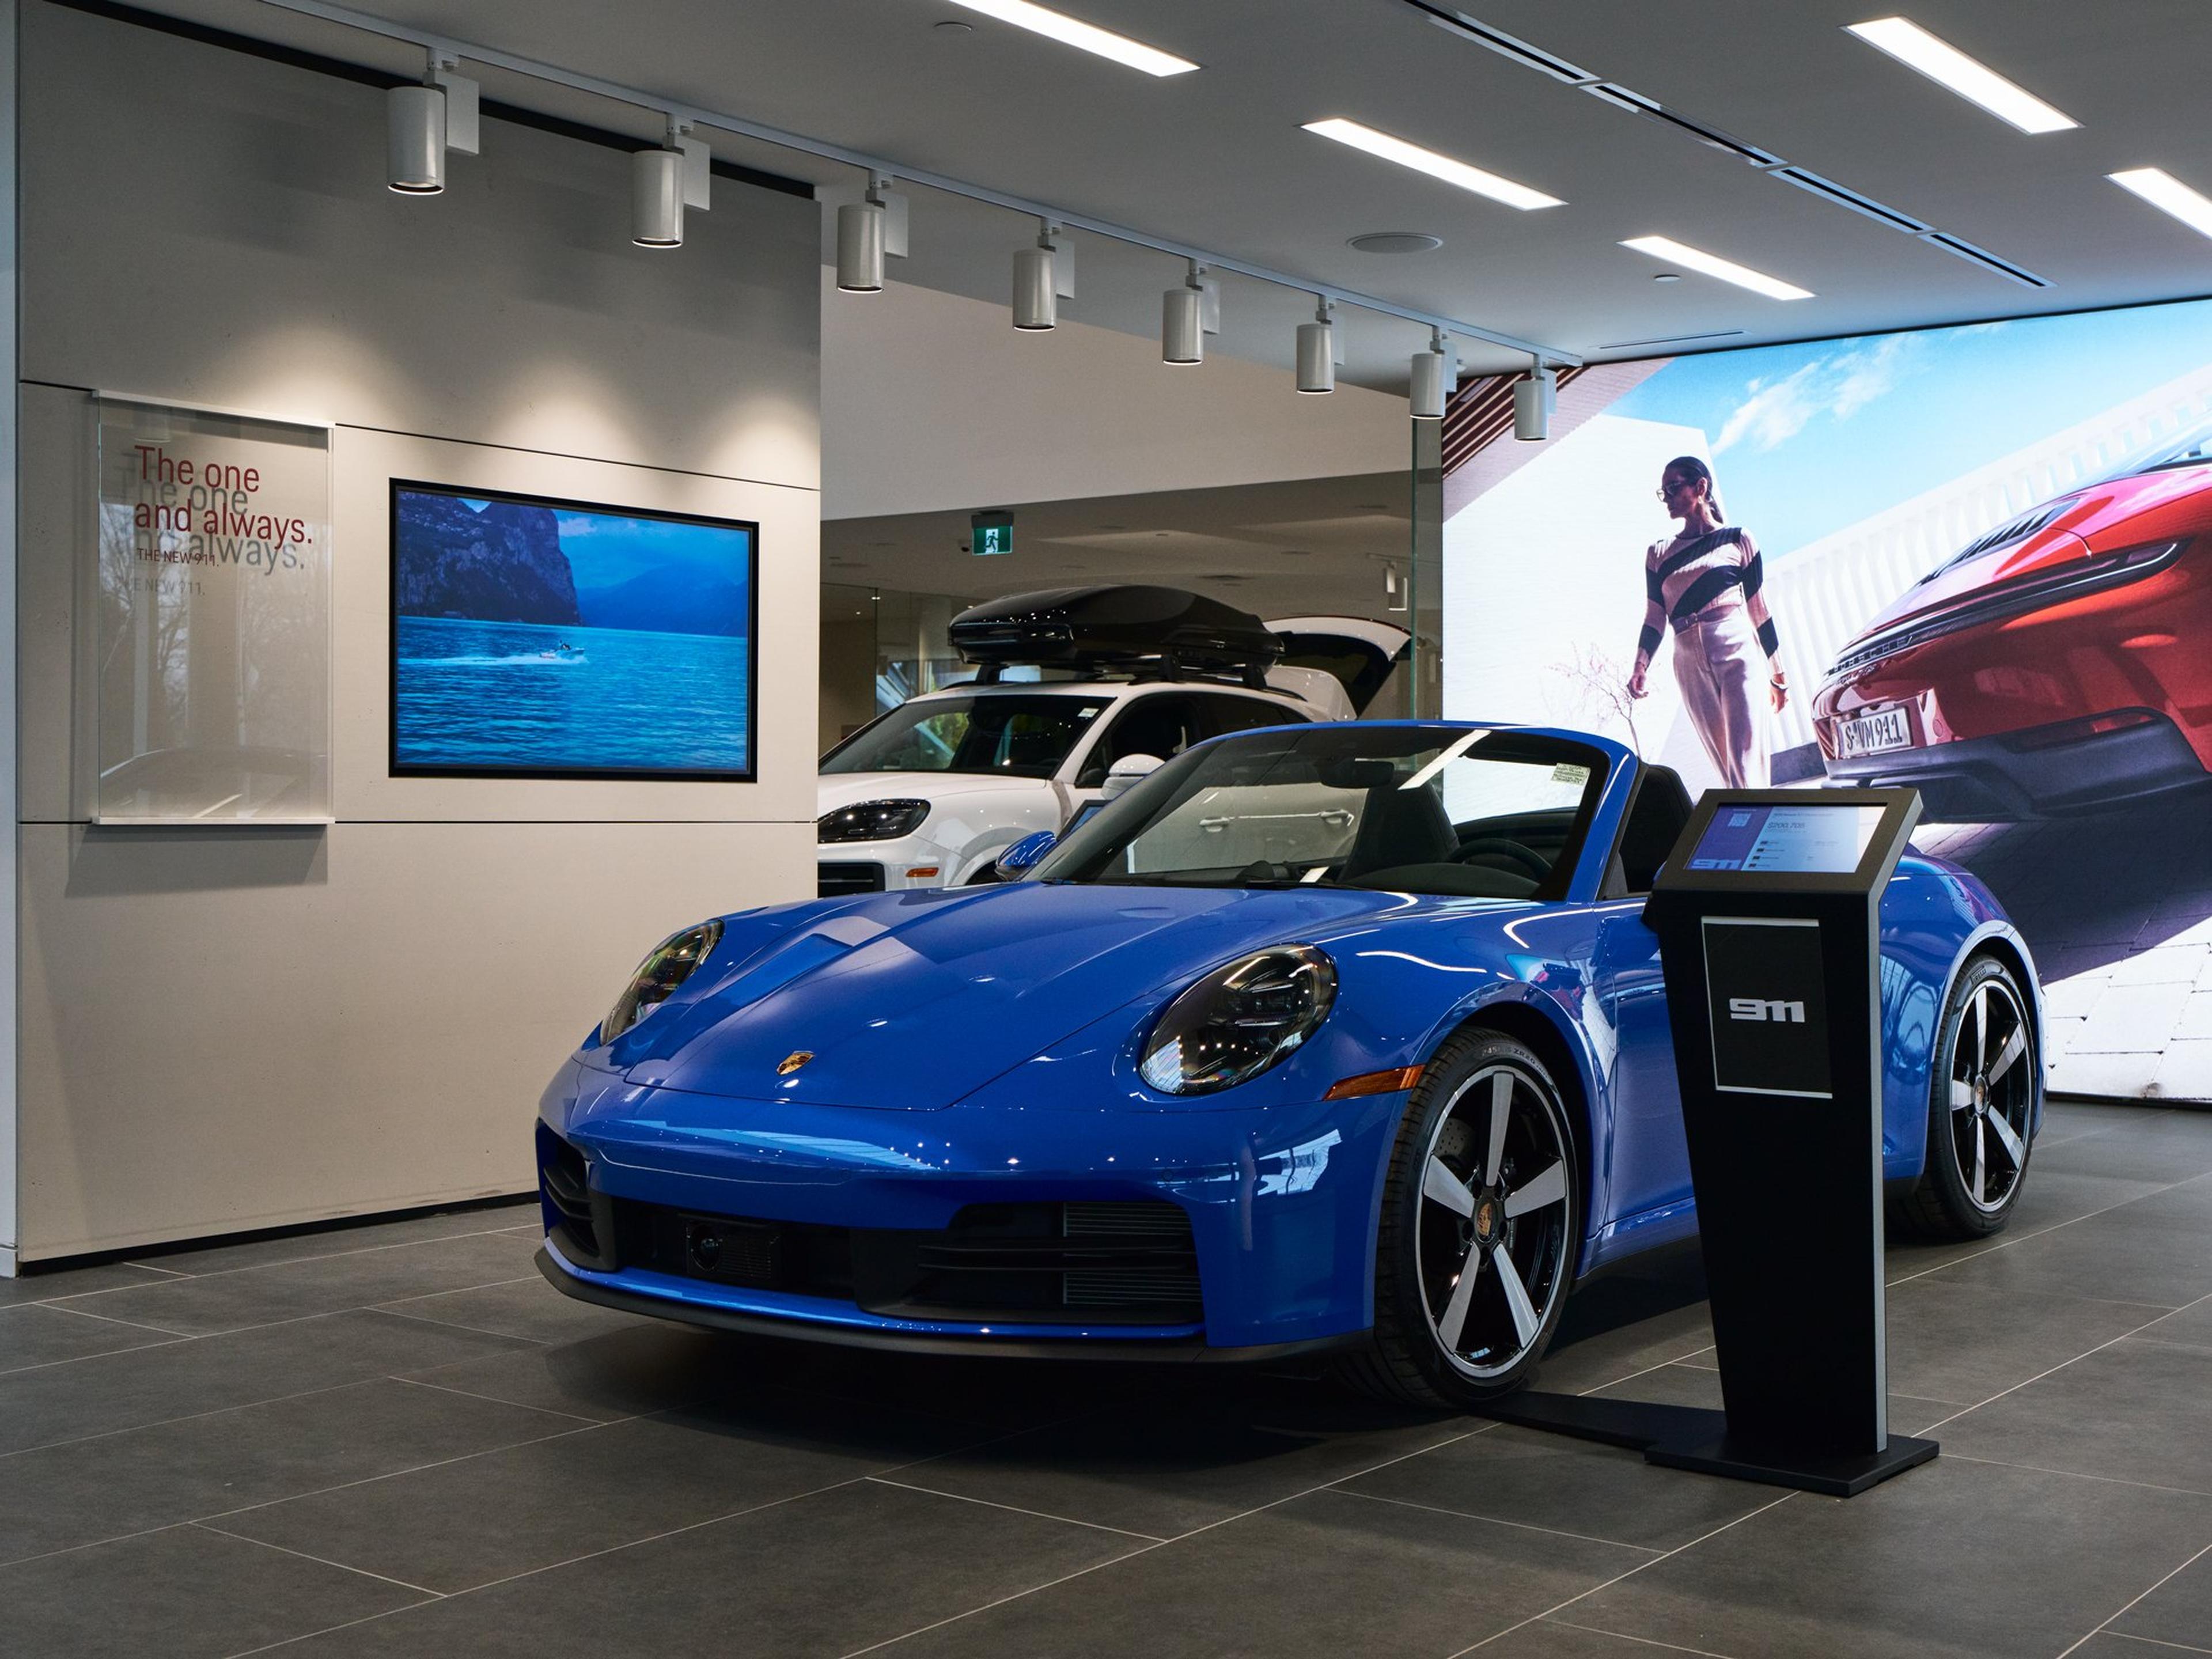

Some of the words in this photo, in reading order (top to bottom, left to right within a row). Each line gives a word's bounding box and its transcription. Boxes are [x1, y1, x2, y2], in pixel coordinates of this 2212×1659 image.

[134, 444, 194, 486] The
[205, 463, 259, 493] one
[134, 498, 192, 532] and
[203, 502, 312, 550] always.
[137, 547, 161, 562] THE
[163, 551, 194, 563] NEW
[1729, 998, 1805, 1022] 911
